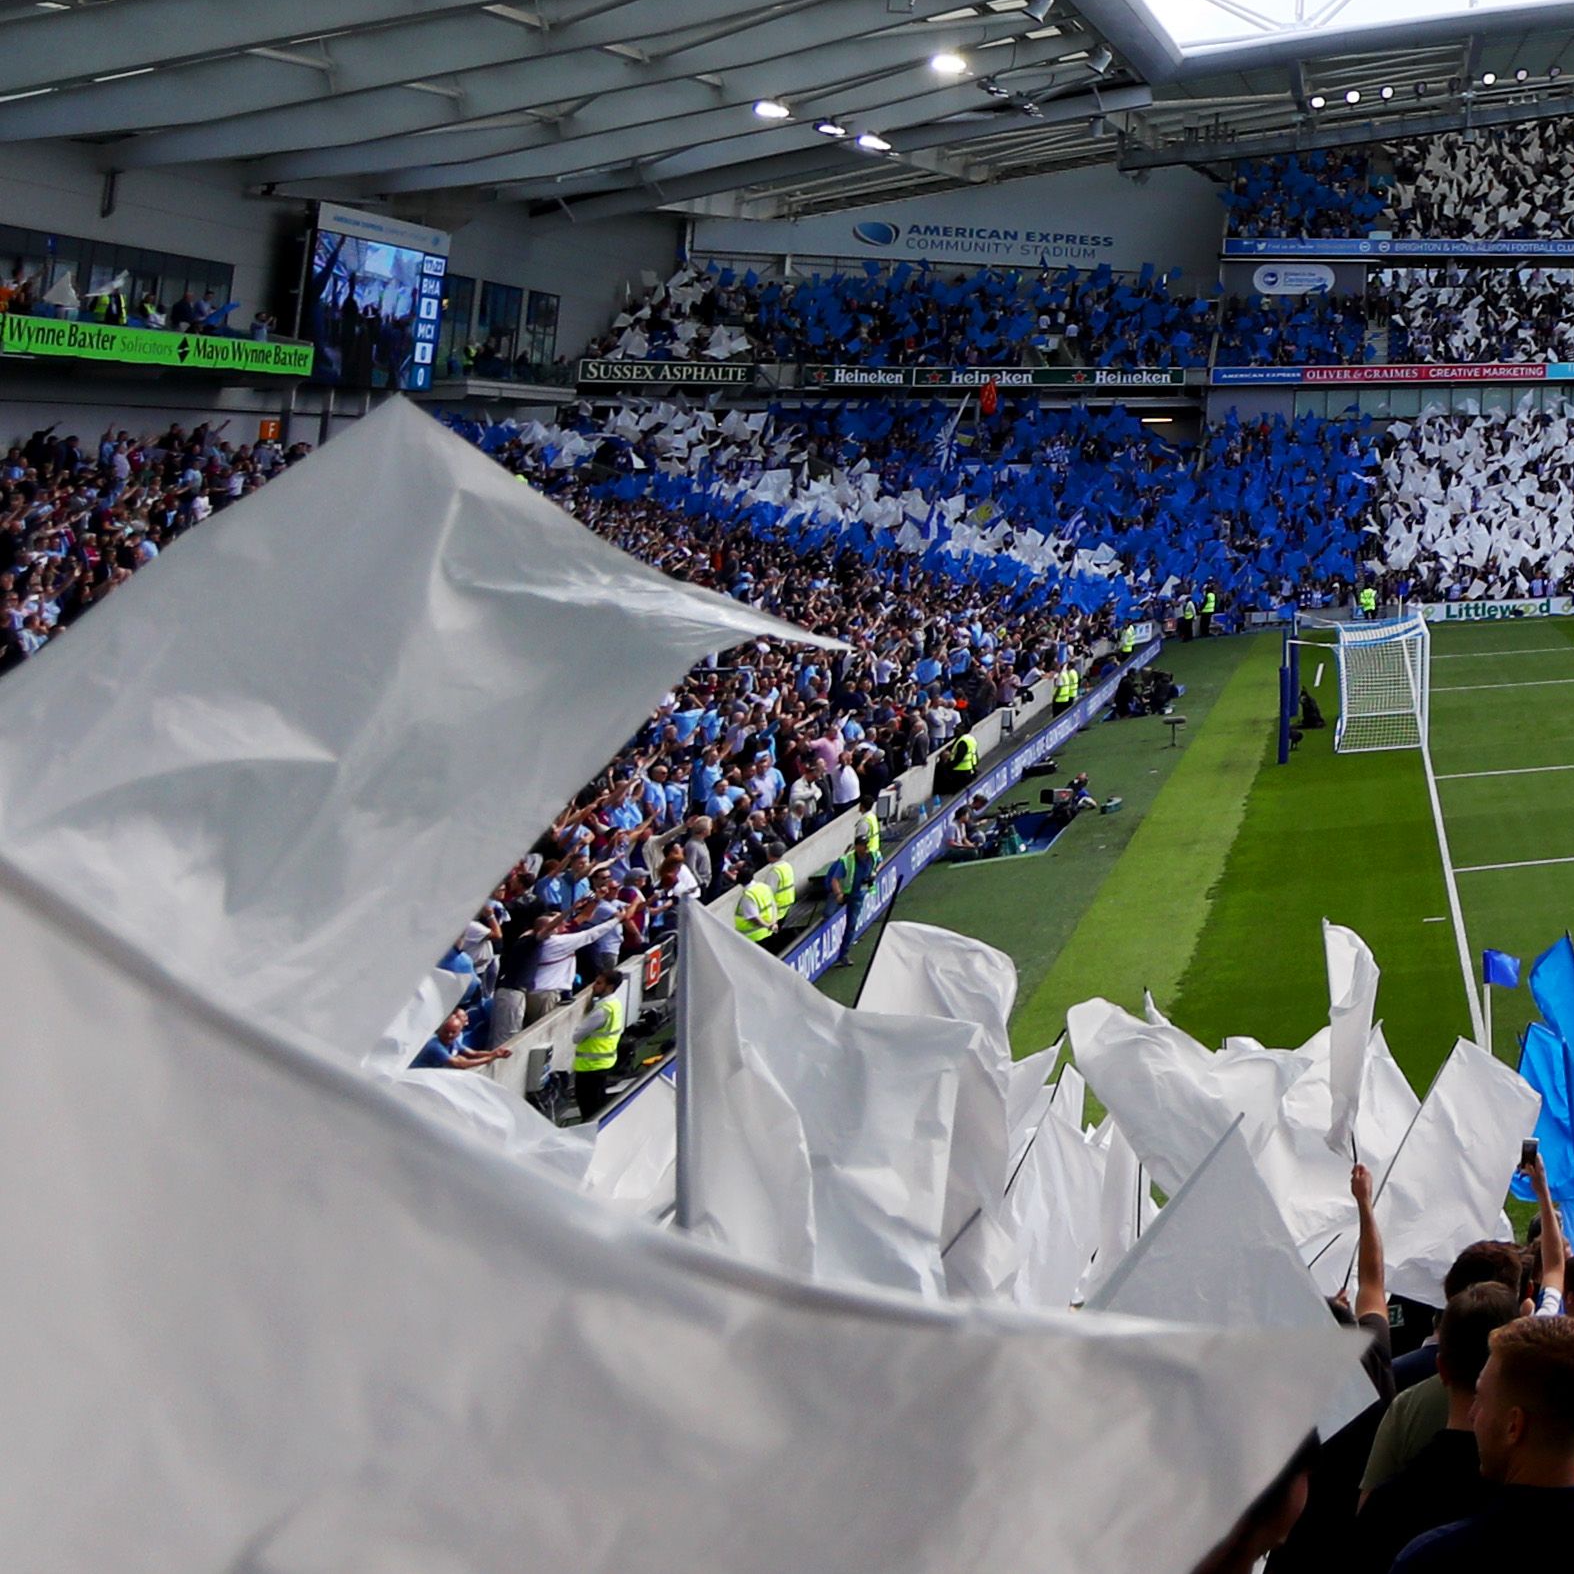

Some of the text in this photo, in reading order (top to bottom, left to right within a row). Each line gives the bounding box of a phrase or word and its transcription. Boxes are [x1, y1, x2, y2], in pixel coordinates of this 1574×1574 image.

[908, 224, 1114, 247] AMERICAN EXPRESS
[905, 237, 1096, 259] COMMUNITY STADIUM
[1395, 243, 1442, 252] BRIGHTON
[1443, 243, 1450, 252] &
[1476, 243, 1509, 252] ALBION
[1511, 243, 1555, 252] FOOTBALL
[421, 277, 441, 296] BHA
[9, 316, 173, 356] Wynne Baxter Solicitors
[194, 338, 309, 370] Mayo Wynne Baxter
[586, 362, 747, 382] SUSSEX ASPHALTE
[833, 368, 904, 384] Heineken
[950, 369, 1033, 384] Heineken
[1095, 369, 1171, 384] Heineken
[1306, 366, 1543, 380] OLIVER & GRAIMES CREATIVE MARKETING
[269, 421, 276, 437] F
[649, 956, 658, 981] C
